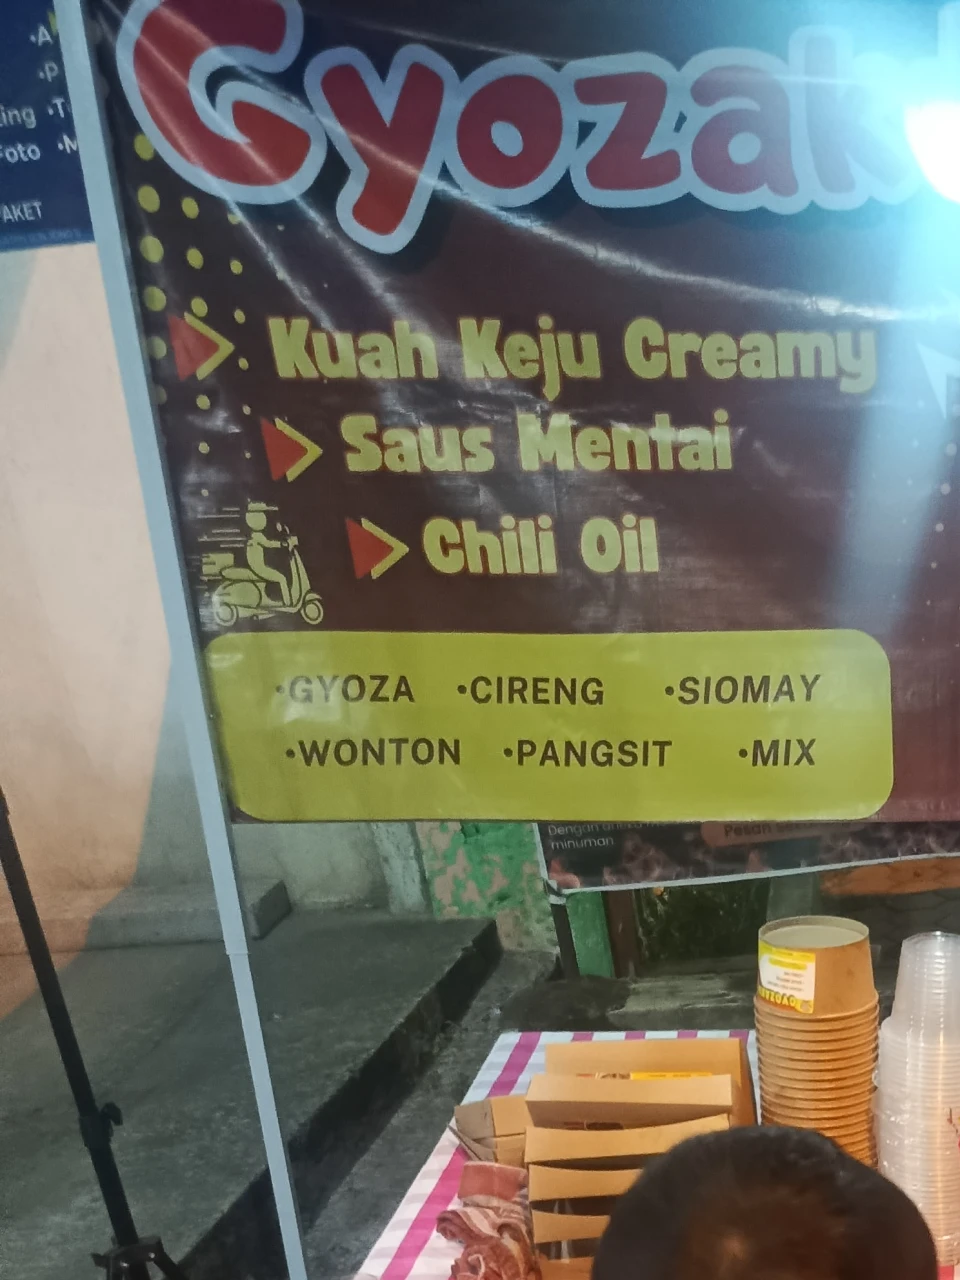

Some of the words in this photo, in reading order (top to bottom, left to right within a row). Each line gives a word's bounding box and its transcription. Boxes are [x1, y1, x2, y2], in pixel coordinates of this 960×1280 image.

[0, 201, 42, 223] AKET
[268, 316, 438, 380] Kuah
[459, 315, 601, 401] Keju
[624, 317, 878, 394] Creamy
[340, 411, 495, 472] Saus
[517, 408, 733, 472] Mentai
[422, 514, 559, 574] Chili
[580, 513, 660, 574] Oil
[288, 674, 415, 703] GYOZA
[470, 676, 605, 706] CIRENG
[677, 674, 821, 705] SIOMAY
[298, 737, 461, 767] WONTON
[516, 739, 673, 767] PANGSIT
[751, 738, 817, 767] MIX
[551, 836, 614, 851] minuman
